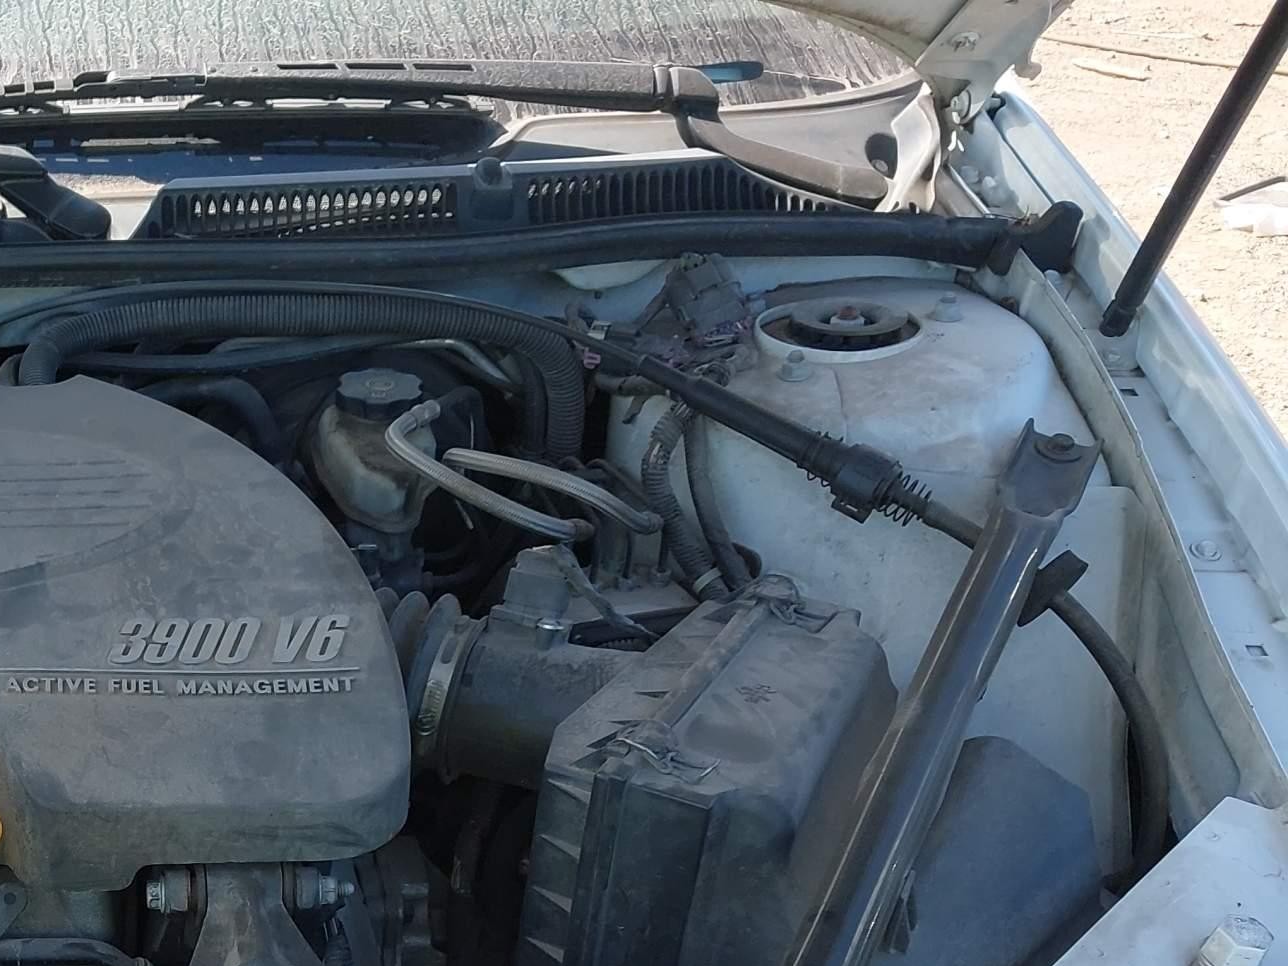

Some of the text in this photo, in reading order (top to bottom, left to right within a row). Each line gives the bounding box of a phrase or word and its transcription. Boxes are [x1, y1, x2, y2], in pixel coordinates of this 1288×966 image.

[108, 614, 350, 665] 3900 V6
[7, 676, 355, 695] ACTIVE FUEL MANAGEMENT
